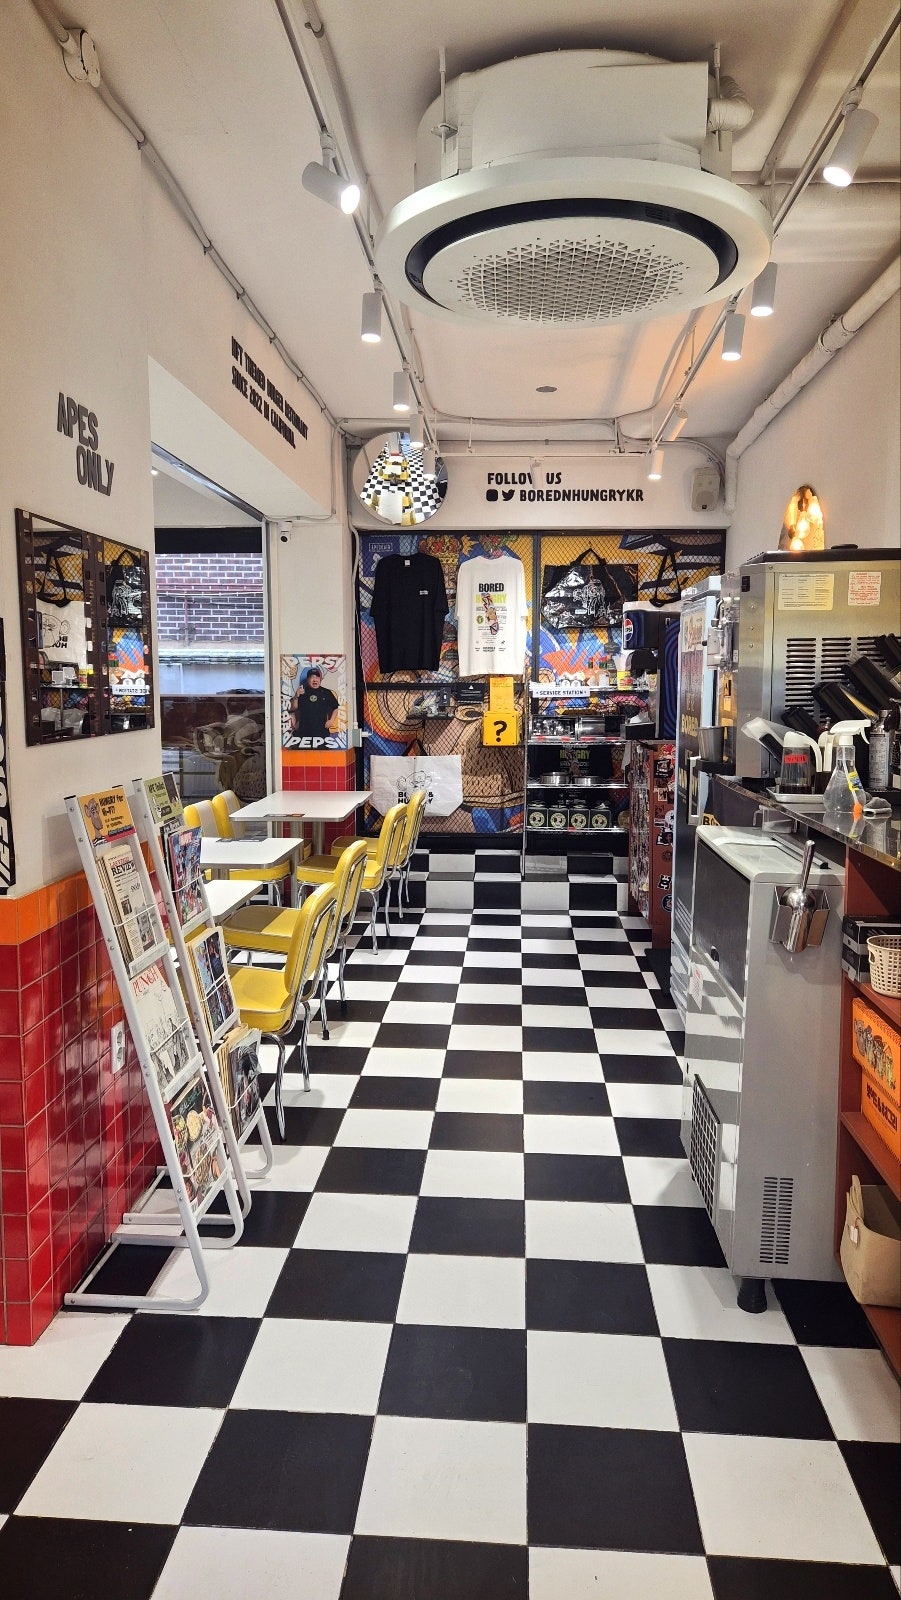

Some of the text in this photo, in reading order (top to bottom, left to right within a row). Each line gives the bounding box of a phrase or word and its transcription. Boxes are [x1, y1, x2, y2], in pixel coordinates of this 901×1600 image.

[232, 366, 248, 399] SINCE
[57, 392, 99, 451] APES
[76, 446, 114, 496] ONLY
[546, 472, 562, 485] US
[520, 489, 644, 502] BOREDNHUNGRYKR
[479, 583, 505, 592] BORED
[285, 736, 347, 748] PEPSI
[132, 964, 159, 997] PUNCH
